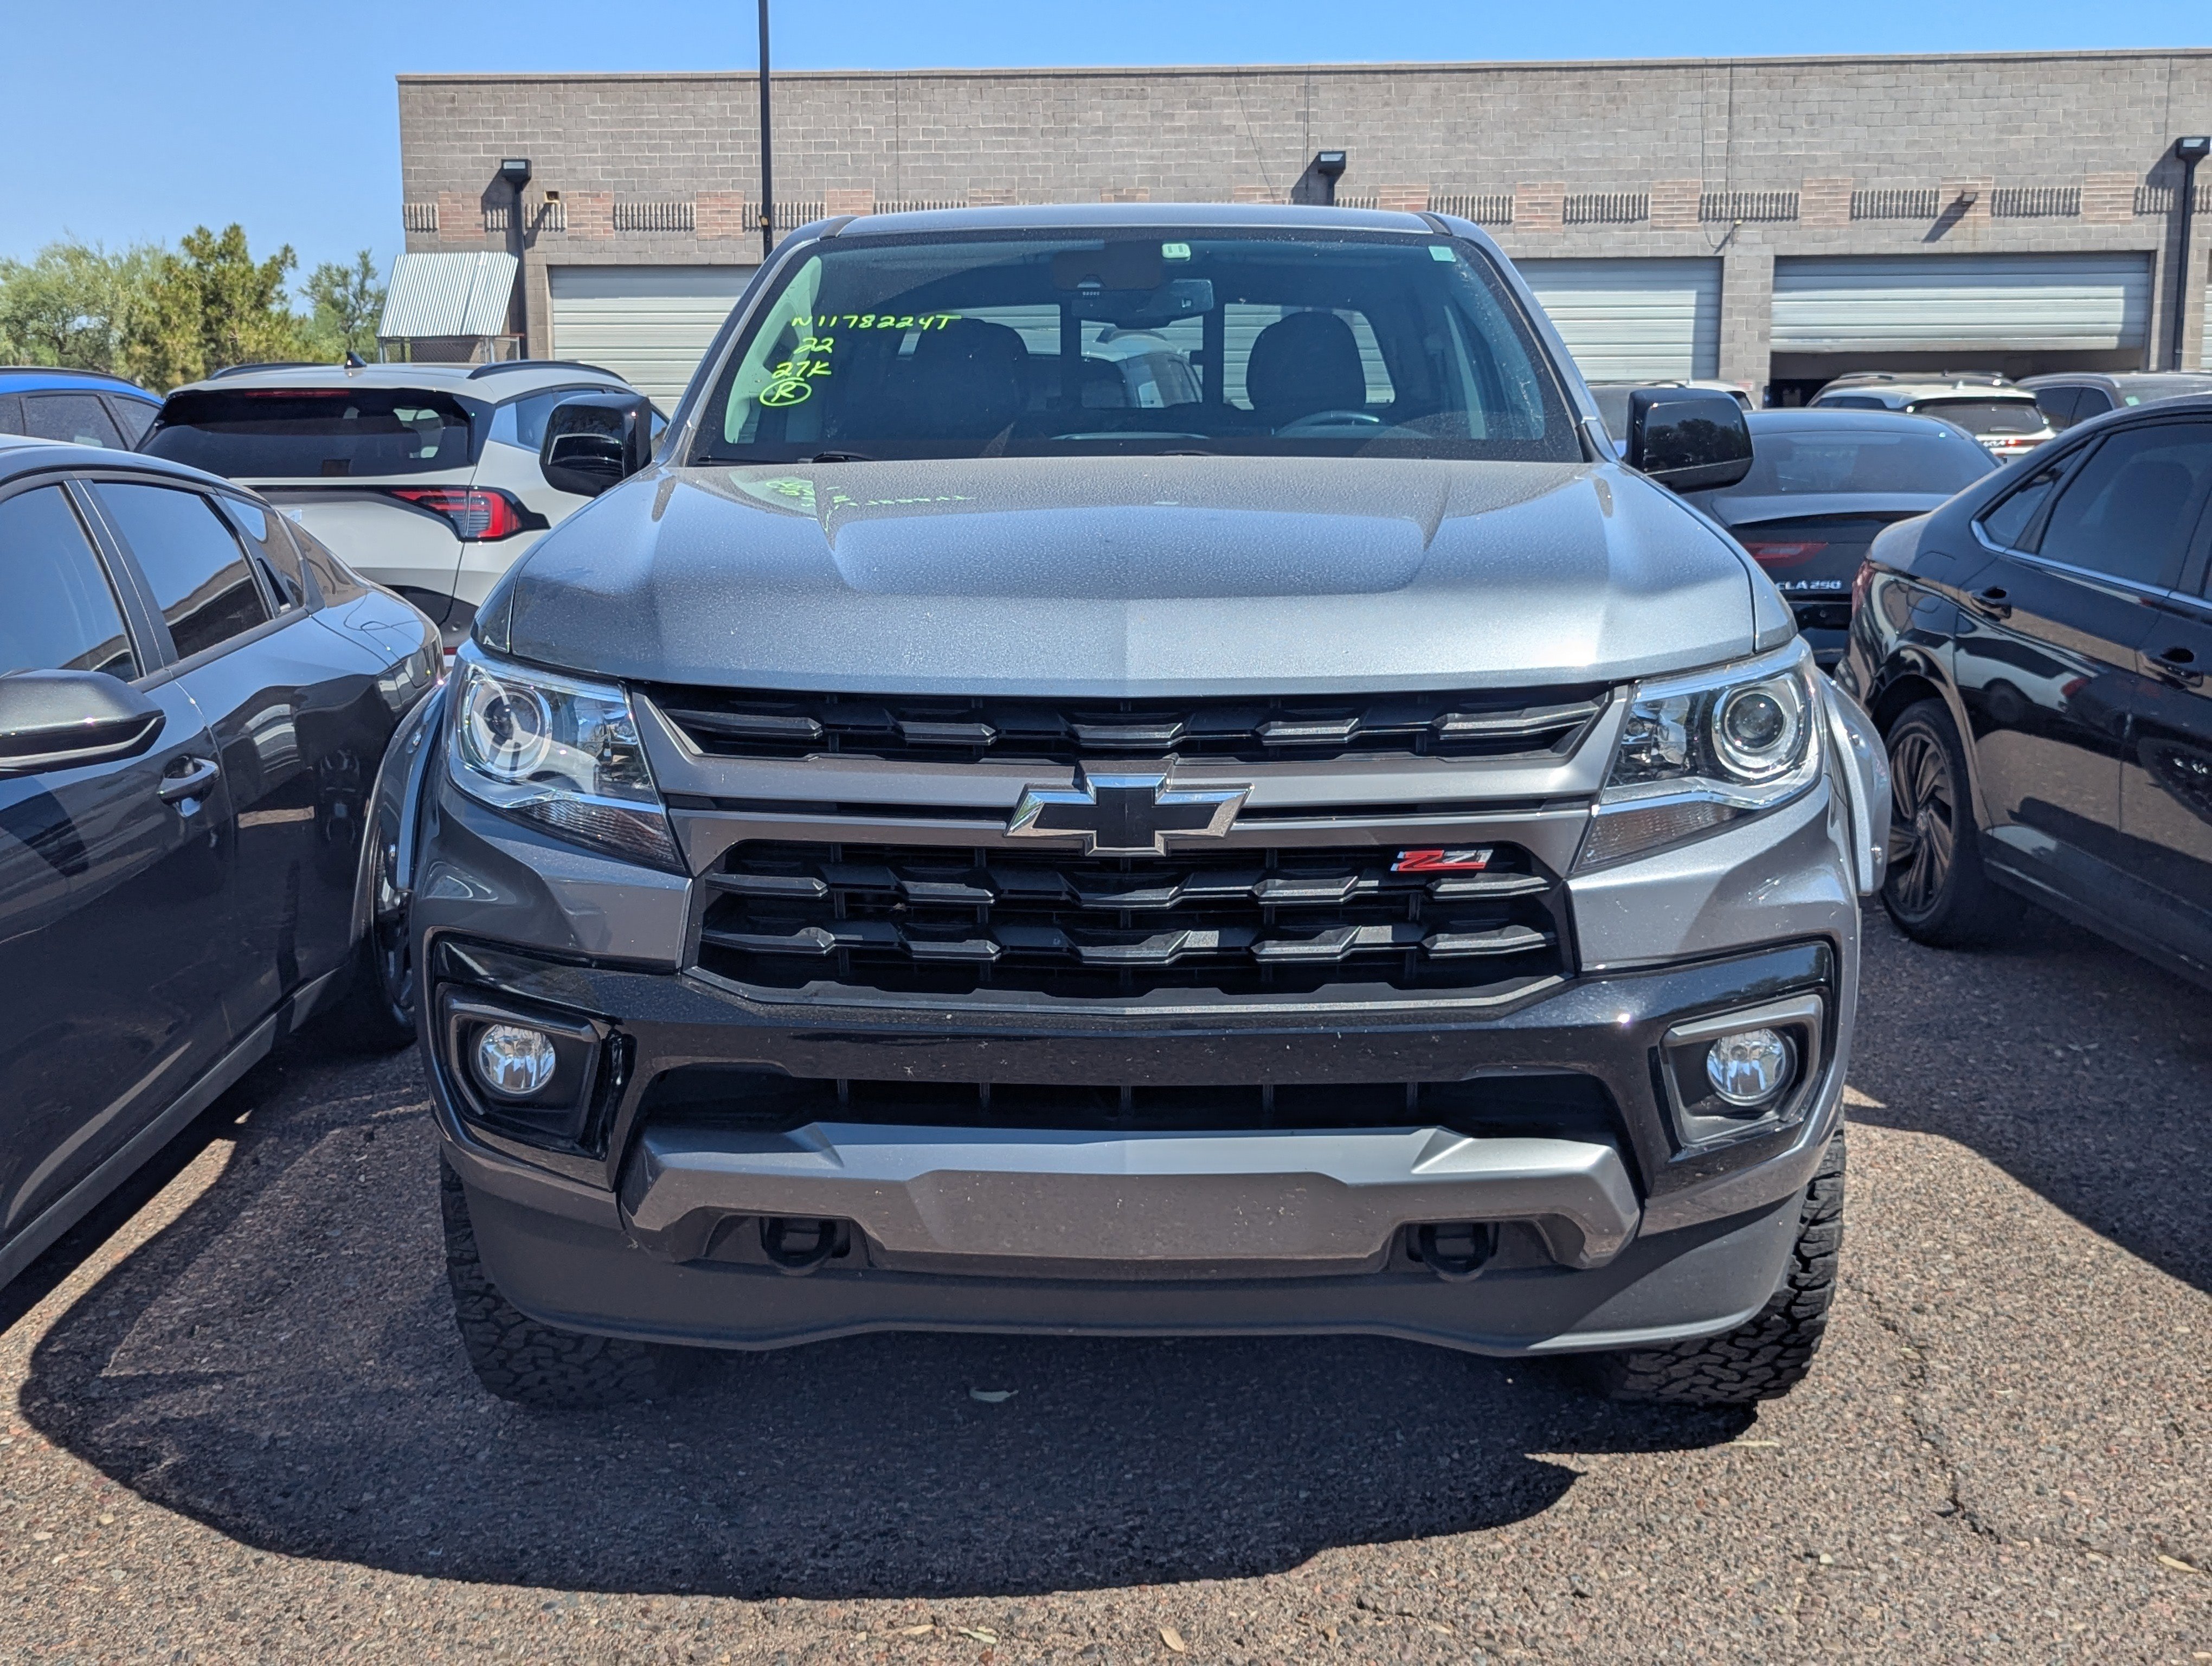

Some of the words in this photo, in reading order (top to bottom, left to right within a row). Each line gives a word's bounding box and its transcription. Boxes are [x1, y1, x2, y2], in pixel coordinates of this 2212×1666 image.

[793, 337, 834, 354] 22
[771, 360, 832, 379] 27K
[1774, 580, 1808, 590] CLA
[1809, 580, 1842, 590] 250
[1390, 849, 1494, 872] Z71
